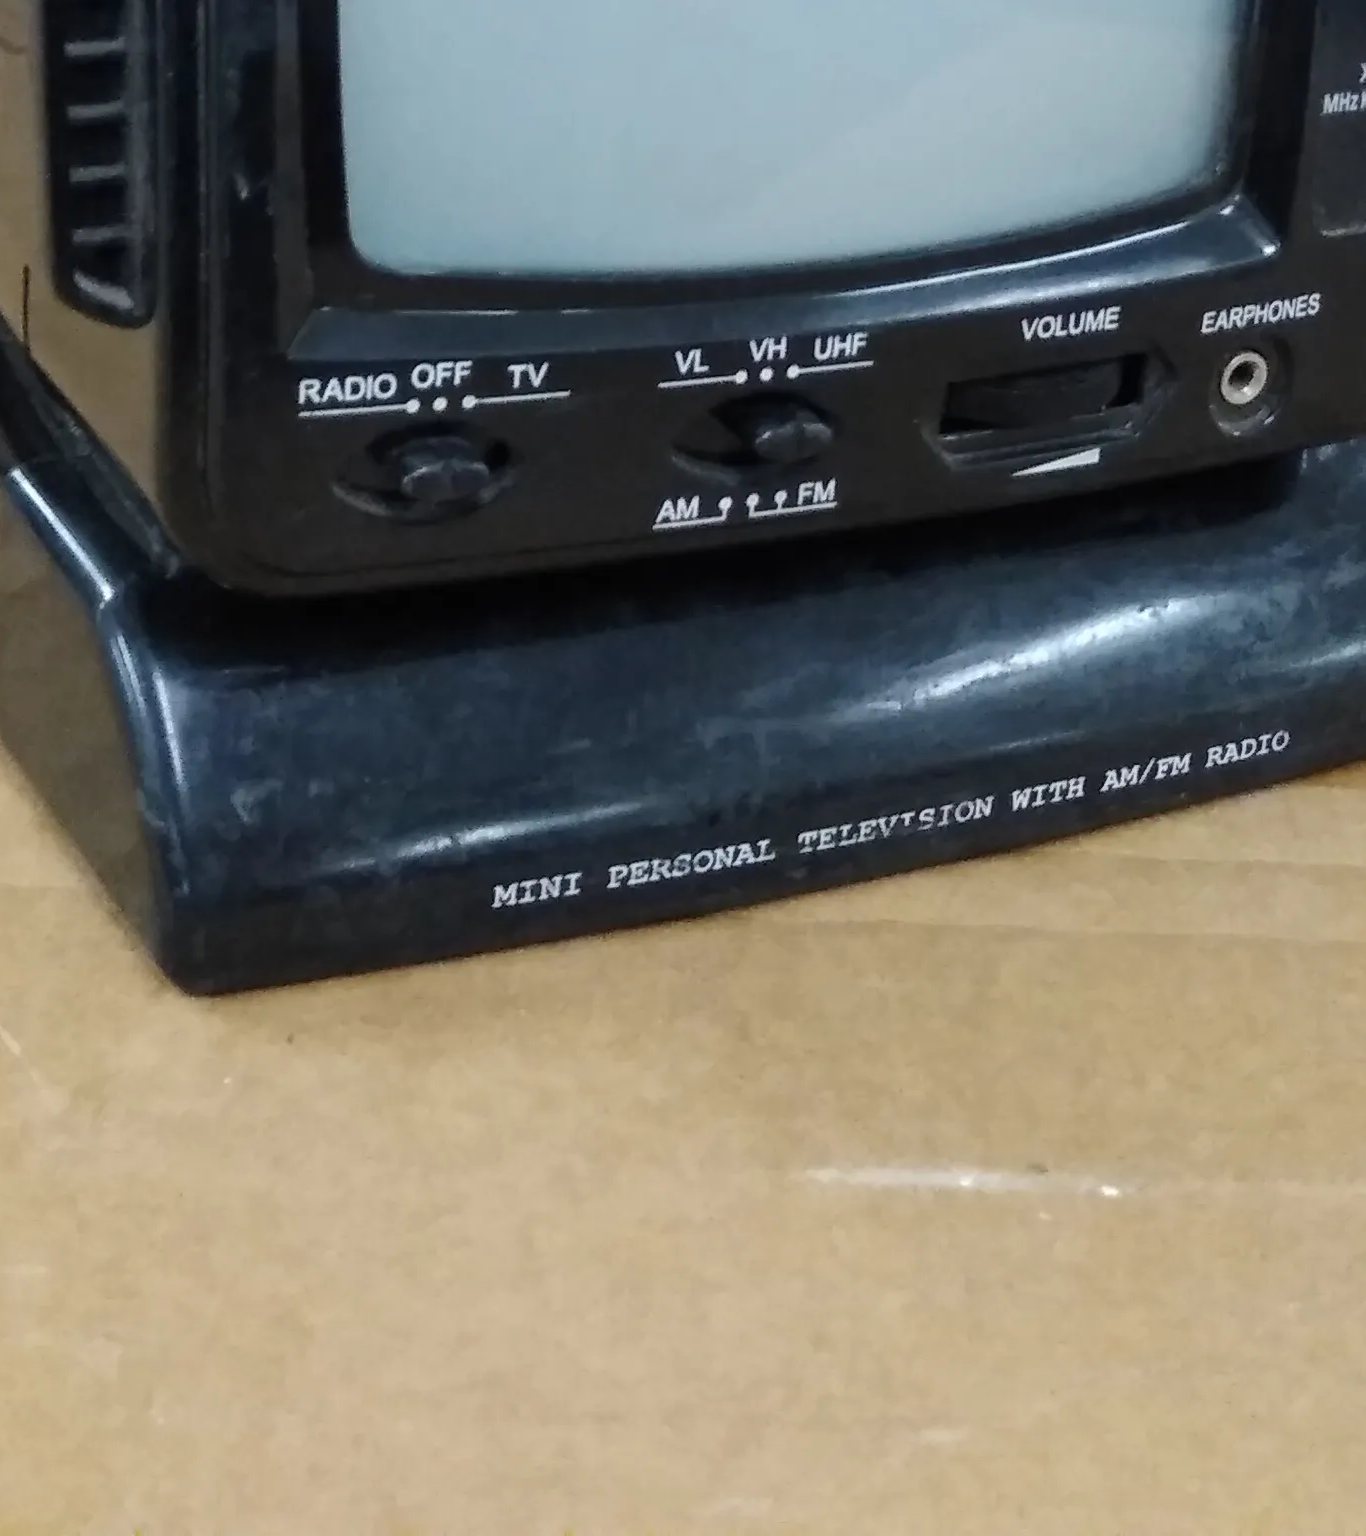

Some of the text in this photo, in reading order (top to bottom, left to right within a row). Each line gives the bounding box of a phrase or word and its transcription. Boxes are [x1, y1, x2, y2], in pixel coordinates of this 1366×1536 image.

[1321, 91, 1358, 116] MHz
[1021, 305, 1122, 342] VOLUME
[1199, 291, 1323, 336] EARPHONES
[674, 330, 869, 376] VL VH UHF
[298, 360, 550, 405] RADIO OFF TV
[655, 477, 837, 524] AM FM
[491, 728, 1292, 909] MINI PERSONAL TELEVISION WITH AM/FM RADIO
